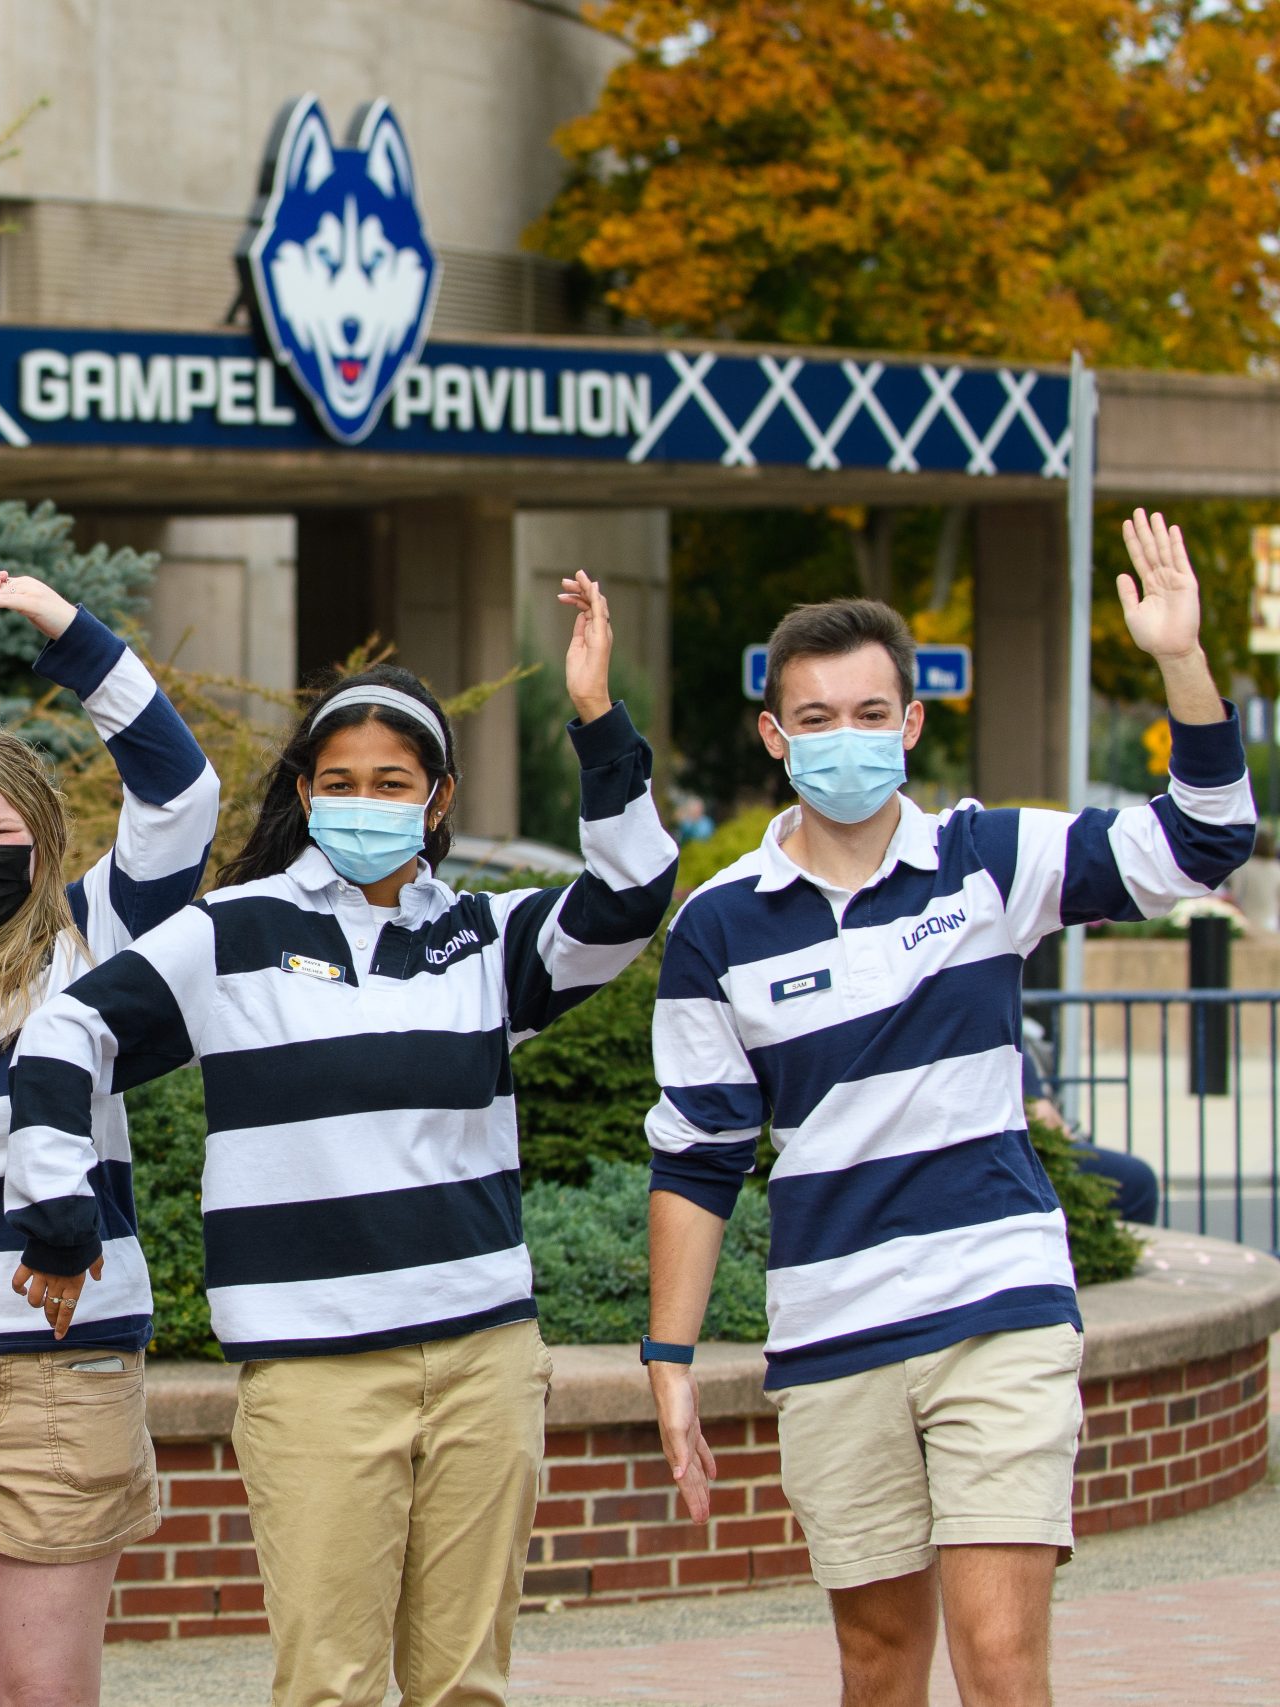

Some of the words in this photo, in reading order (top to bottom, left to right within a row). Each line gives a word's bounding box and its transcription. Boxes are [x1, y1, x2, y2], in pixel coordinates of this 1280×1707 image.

[19, 349, 296, 425] GAMPEL
[392, 363, 650, 437] PAVILION
[425, 928, 479, 965] UCONN
[901, 908, 967, 951] UCONN
[792, 981, 808, 990] SAM
